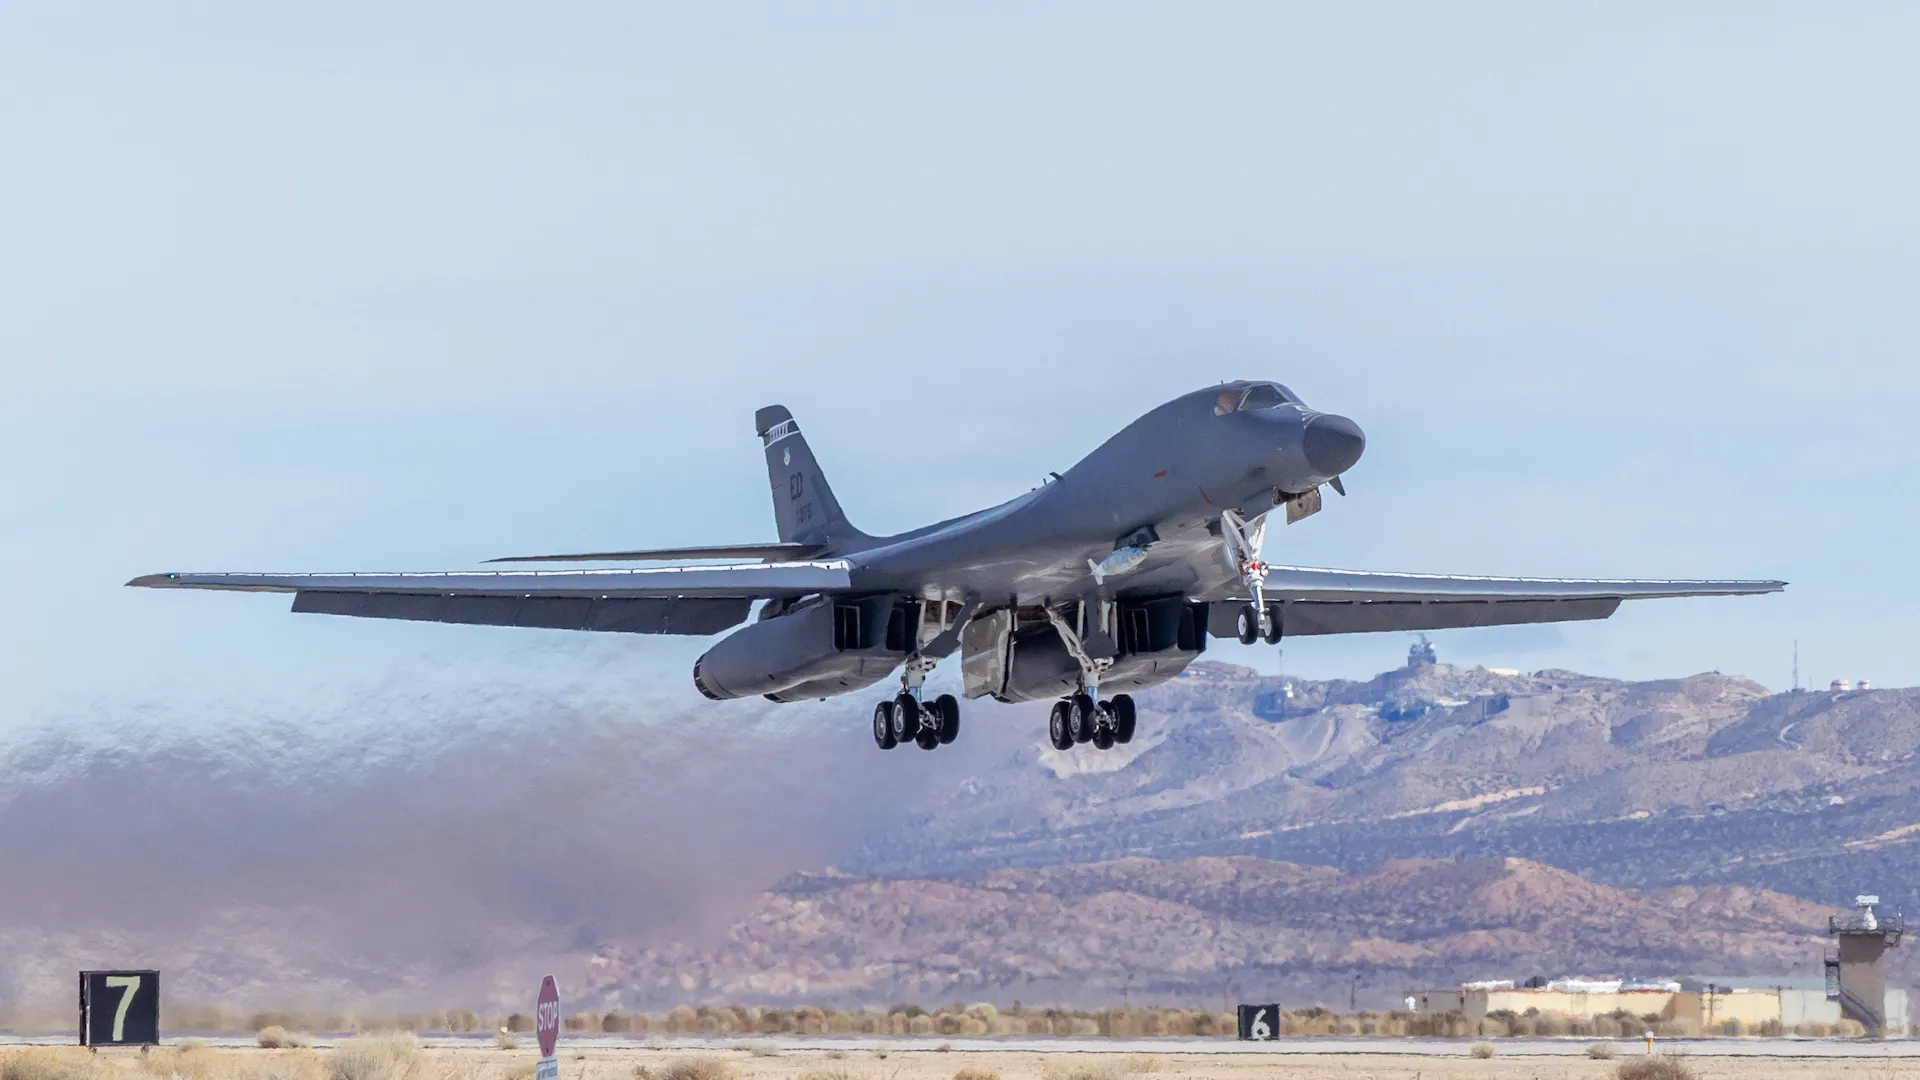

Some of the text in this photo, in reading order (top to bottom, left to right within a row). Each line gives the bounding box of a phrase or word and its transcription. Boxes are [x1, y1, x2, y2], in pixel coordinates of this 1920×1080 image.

[790, 472, 803, 501] ED
[105, 975, 141, 1041] 7
[538, 1001, 558, 1031] STOP
[1251, 1008, 1271, 1040] 6
